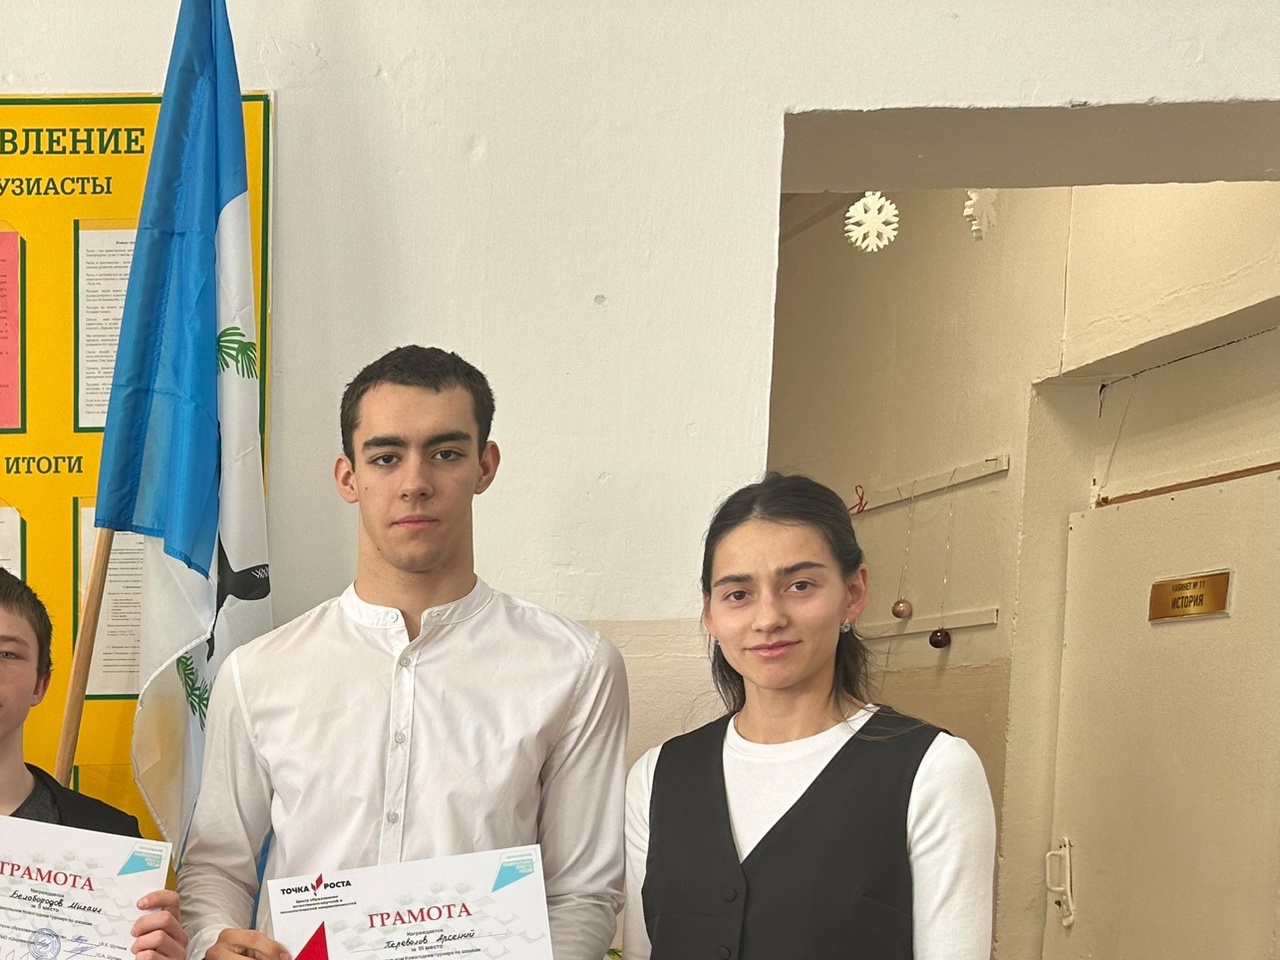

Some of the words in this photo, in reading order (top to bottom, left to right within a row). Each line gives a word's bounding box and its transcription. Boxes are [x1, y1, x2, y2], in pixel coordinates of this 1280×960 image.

[4, 456, 83, 474] ИТОГИ
[1171, 593, 1204, 610] ИСТОРИЯ
[280, 885, 310, 895] ТОЧКА
[324, 880, 352, 889] РОСТА
[368, 902, 472, 928] ГРАМОТА
[436, 929, 475, 943] Арсений
